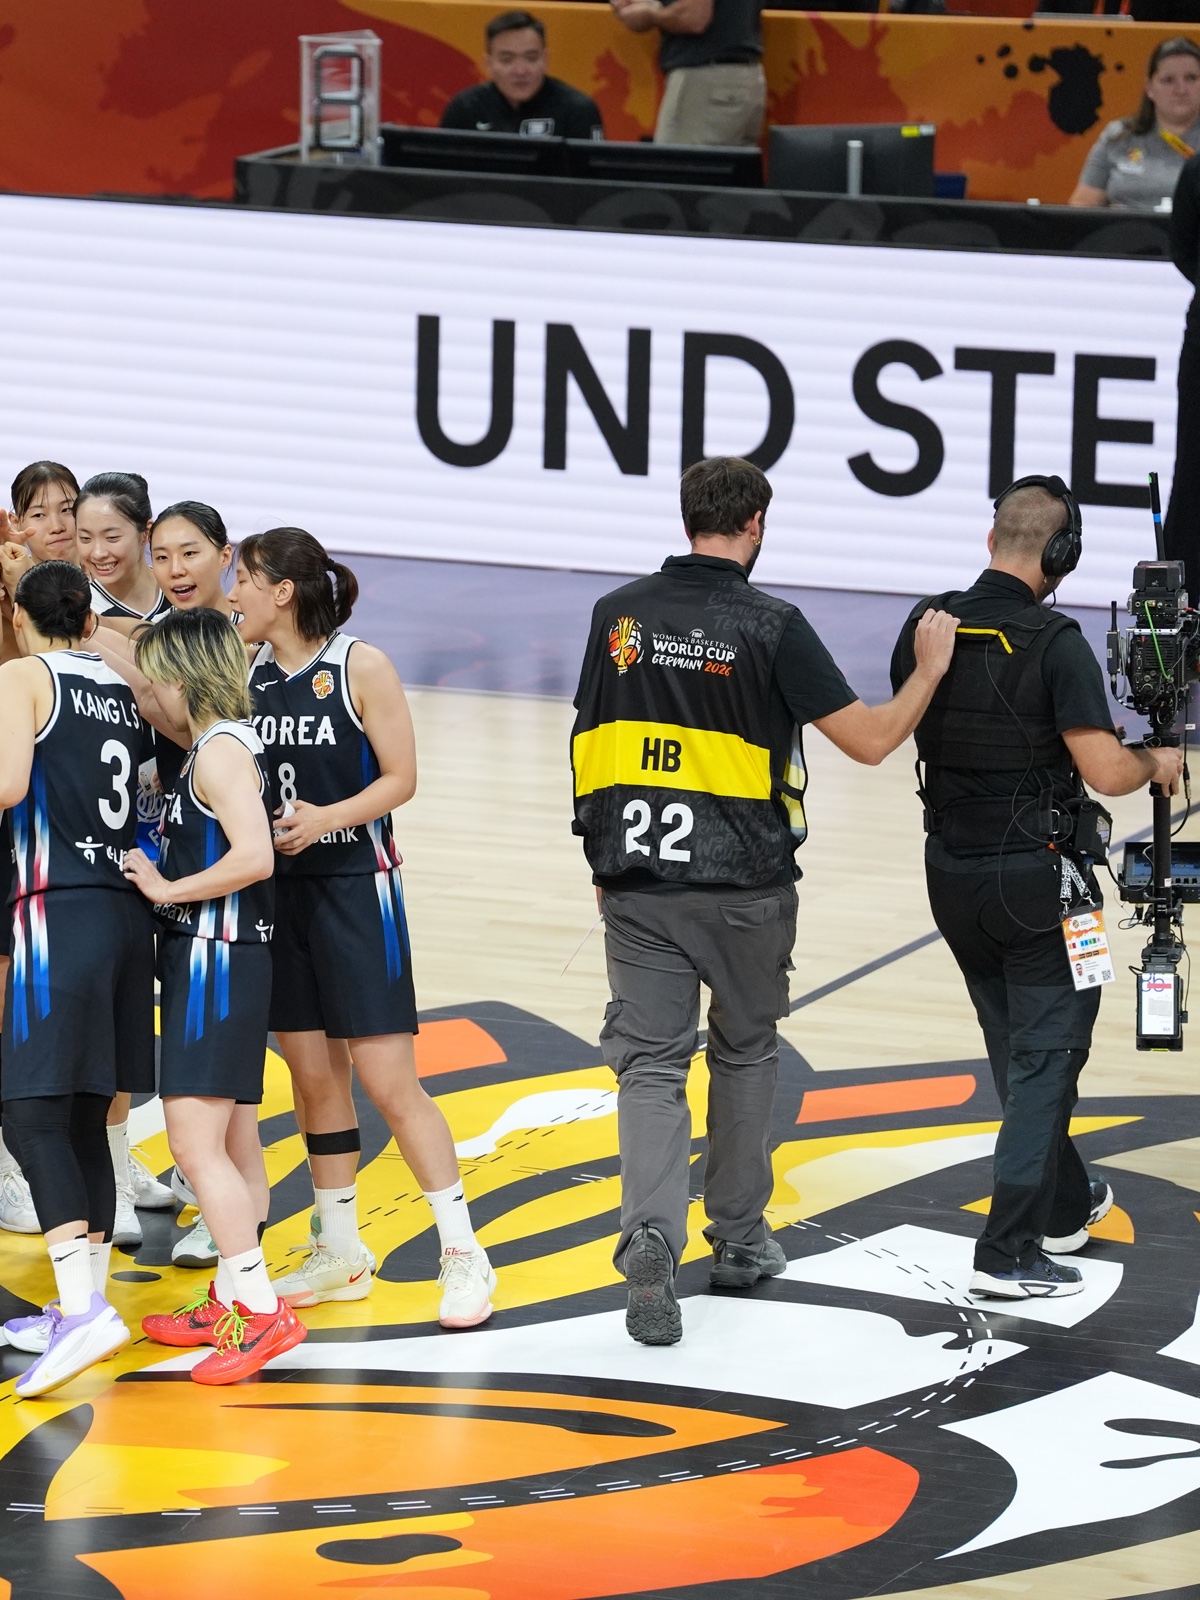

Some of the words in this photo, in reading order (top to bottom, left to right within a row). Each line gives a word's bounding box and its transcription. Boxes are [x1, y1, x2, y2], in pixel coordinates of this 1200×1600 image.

[415, 314, 795, 478] UND
[847, 339, 1157, 508] STE
[652, 632, 689, 643] WOMEN'S
[690, 637, 738, 653] BASKETBALL
[653, 639, 703, 657] WORLD
[706, 647, 736, 663] CUP
[651, 653, 703, 671] GERMANY
[704, 661, 733, 677] 2026
[70, 688, 120, 725] KANG
[120, 700, 132, 727] L
[130, 702, 140, 730] S
[641, 737, 682, 773] HB
[99, 739, 131, 830] 3
[278, 762, 298, 804] 8
[313, 826, 359, 845] ank
[622, 799, 694, 863] 22
